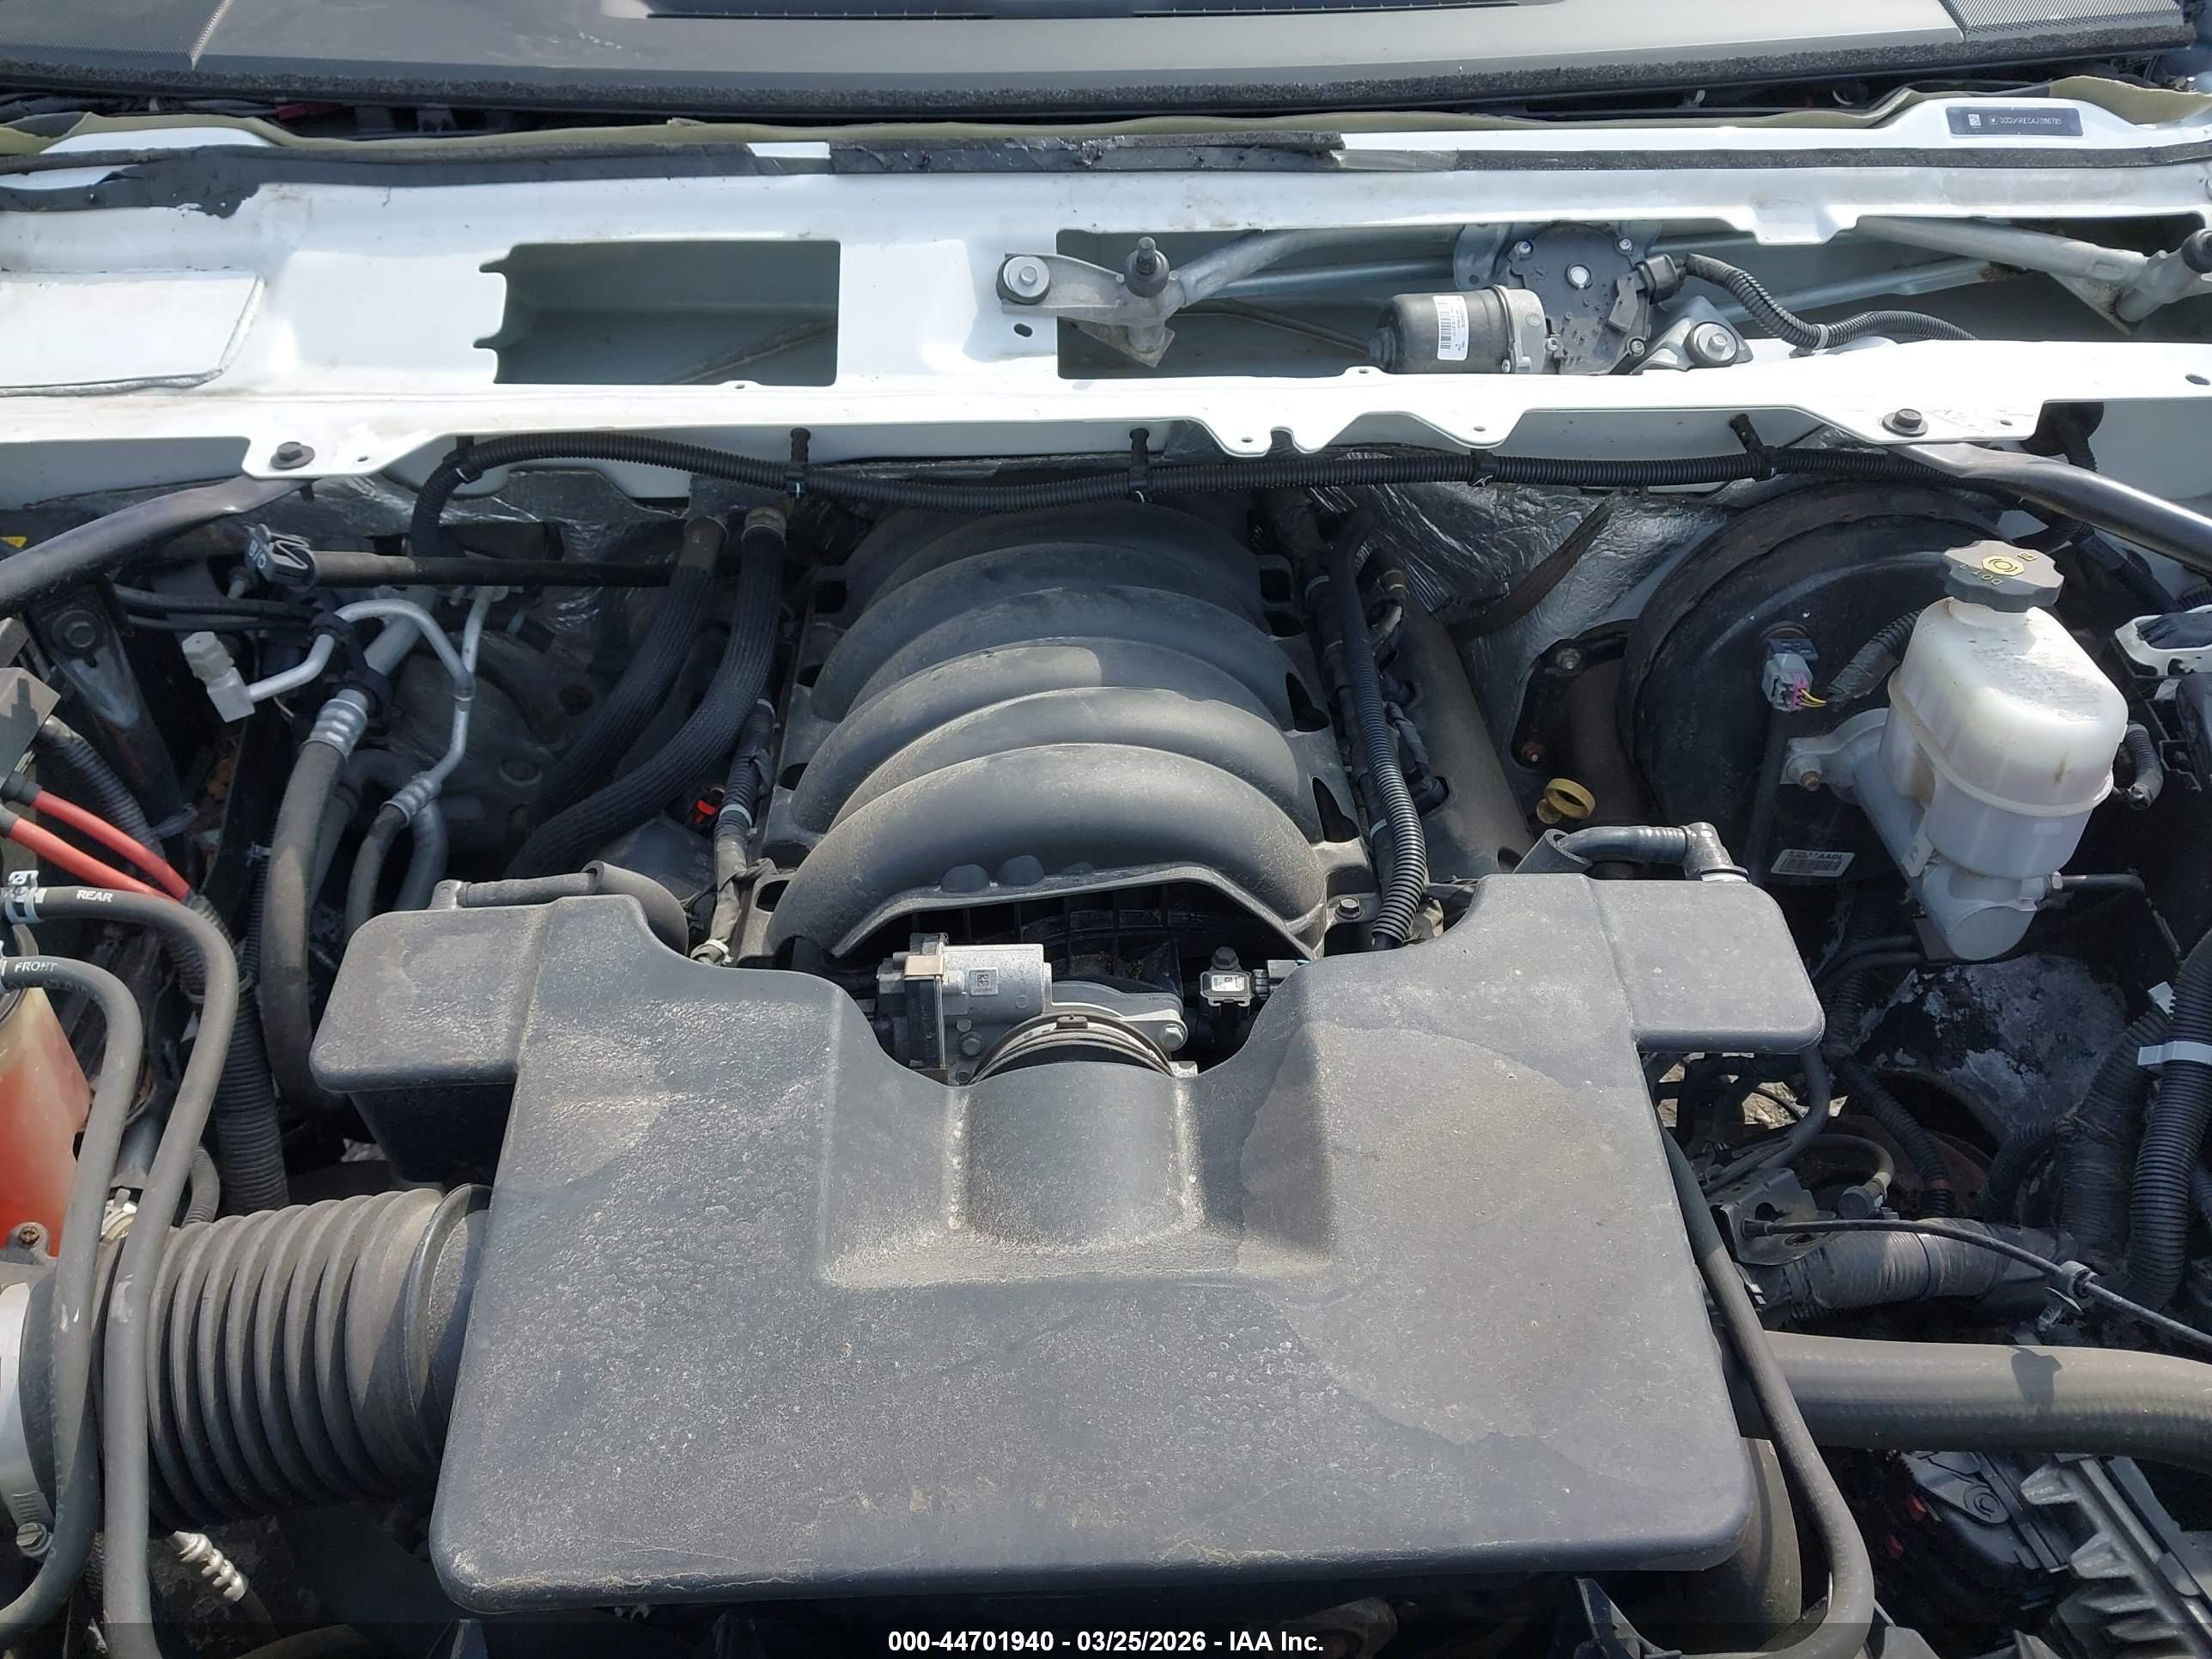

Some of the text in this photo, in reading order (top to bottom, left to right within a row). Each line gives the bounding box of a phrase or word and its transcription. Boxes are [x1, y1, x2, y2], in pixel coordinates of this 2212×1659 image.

[1971, 568, 2003, 586] DOT
[76, 890, 113, 902] REAR
[14, 961, 58, 973] FRONT
